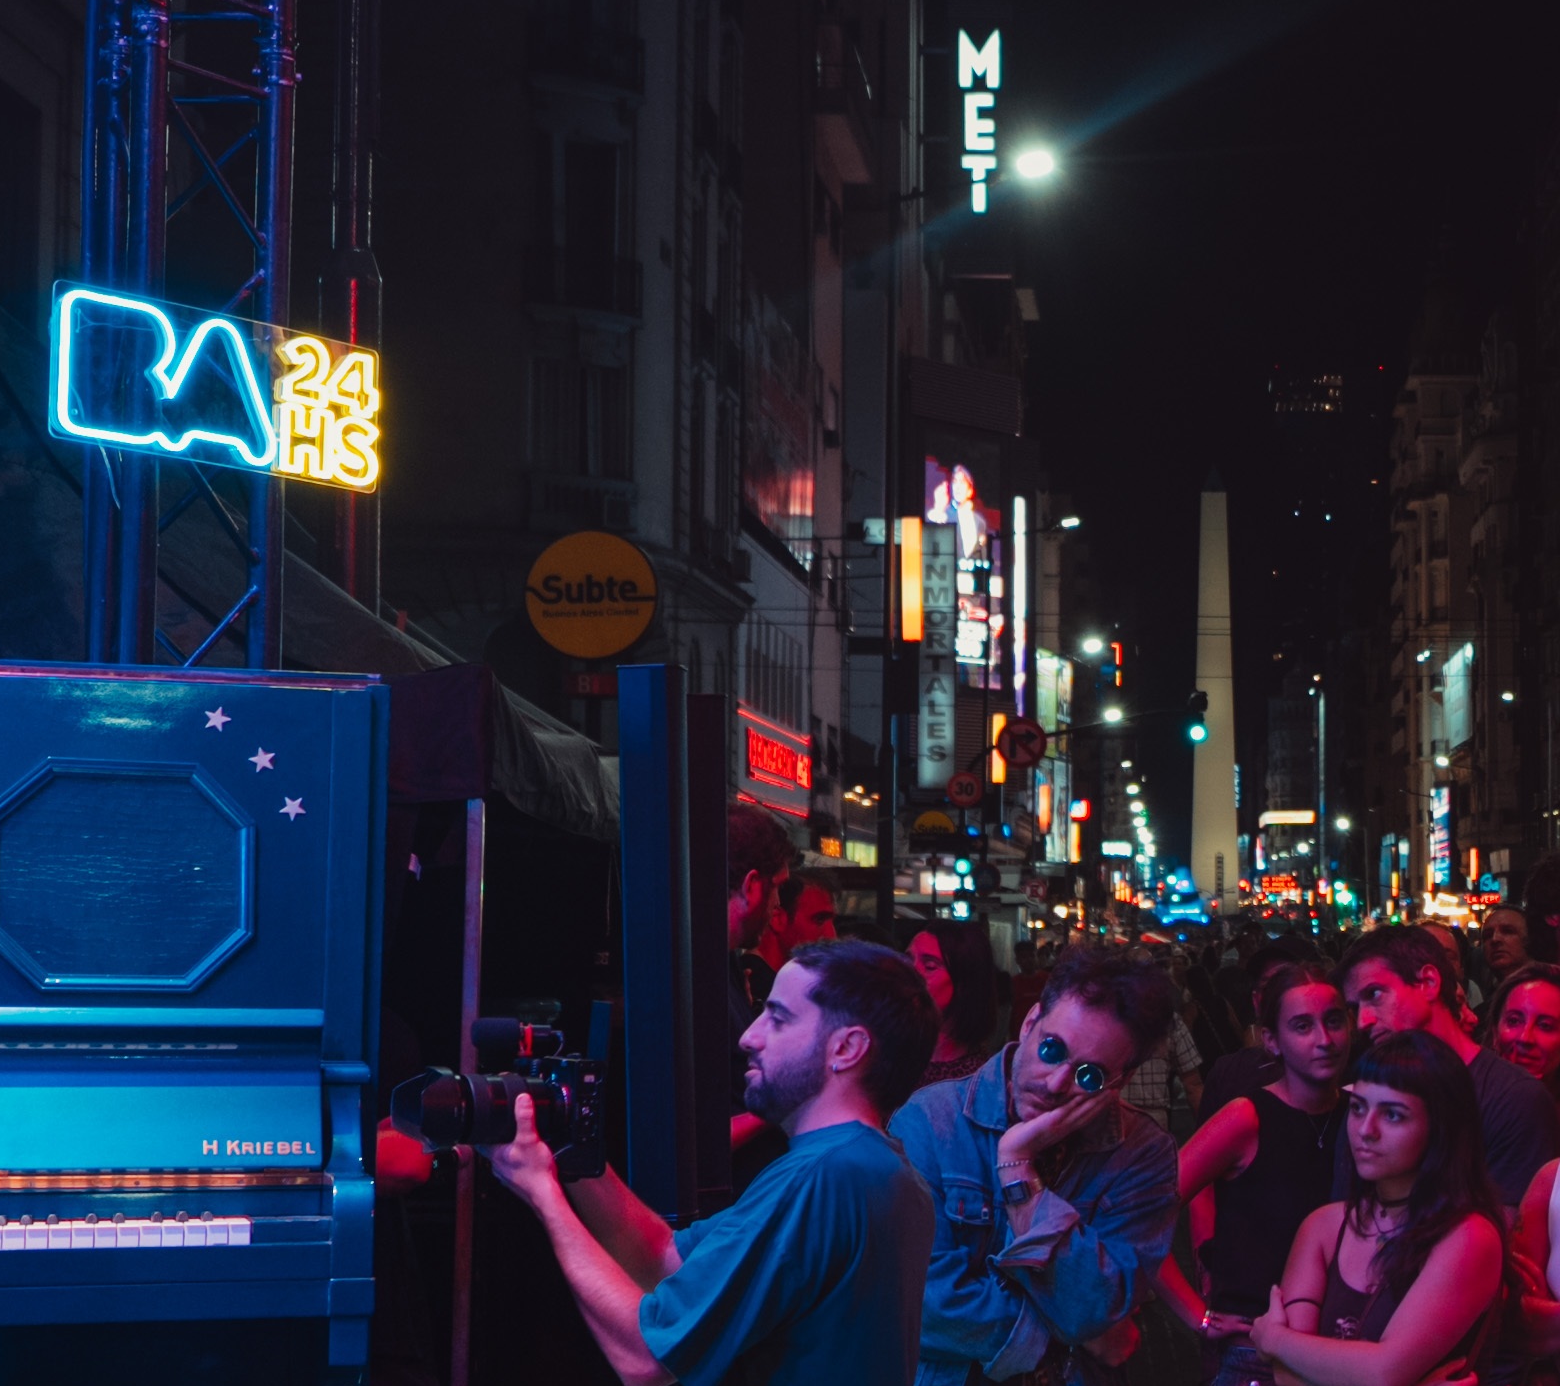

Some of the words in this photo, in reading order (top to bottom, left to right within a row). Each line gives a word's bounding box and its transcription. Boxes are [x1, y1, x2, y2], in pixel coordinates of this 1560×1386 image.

[277, 336, 380, 419] 24
[277, 405, 380, 489] HS
[541, 574, 638, 604] Subte
[923, 541, 950, 763] INMORTALES
[578, 675, 591, 693] B
[954, 782, 974, 797] 30
[203, 1139, 218, 1155] H
[226, 1139, 316, 1155] KRIEBEL
